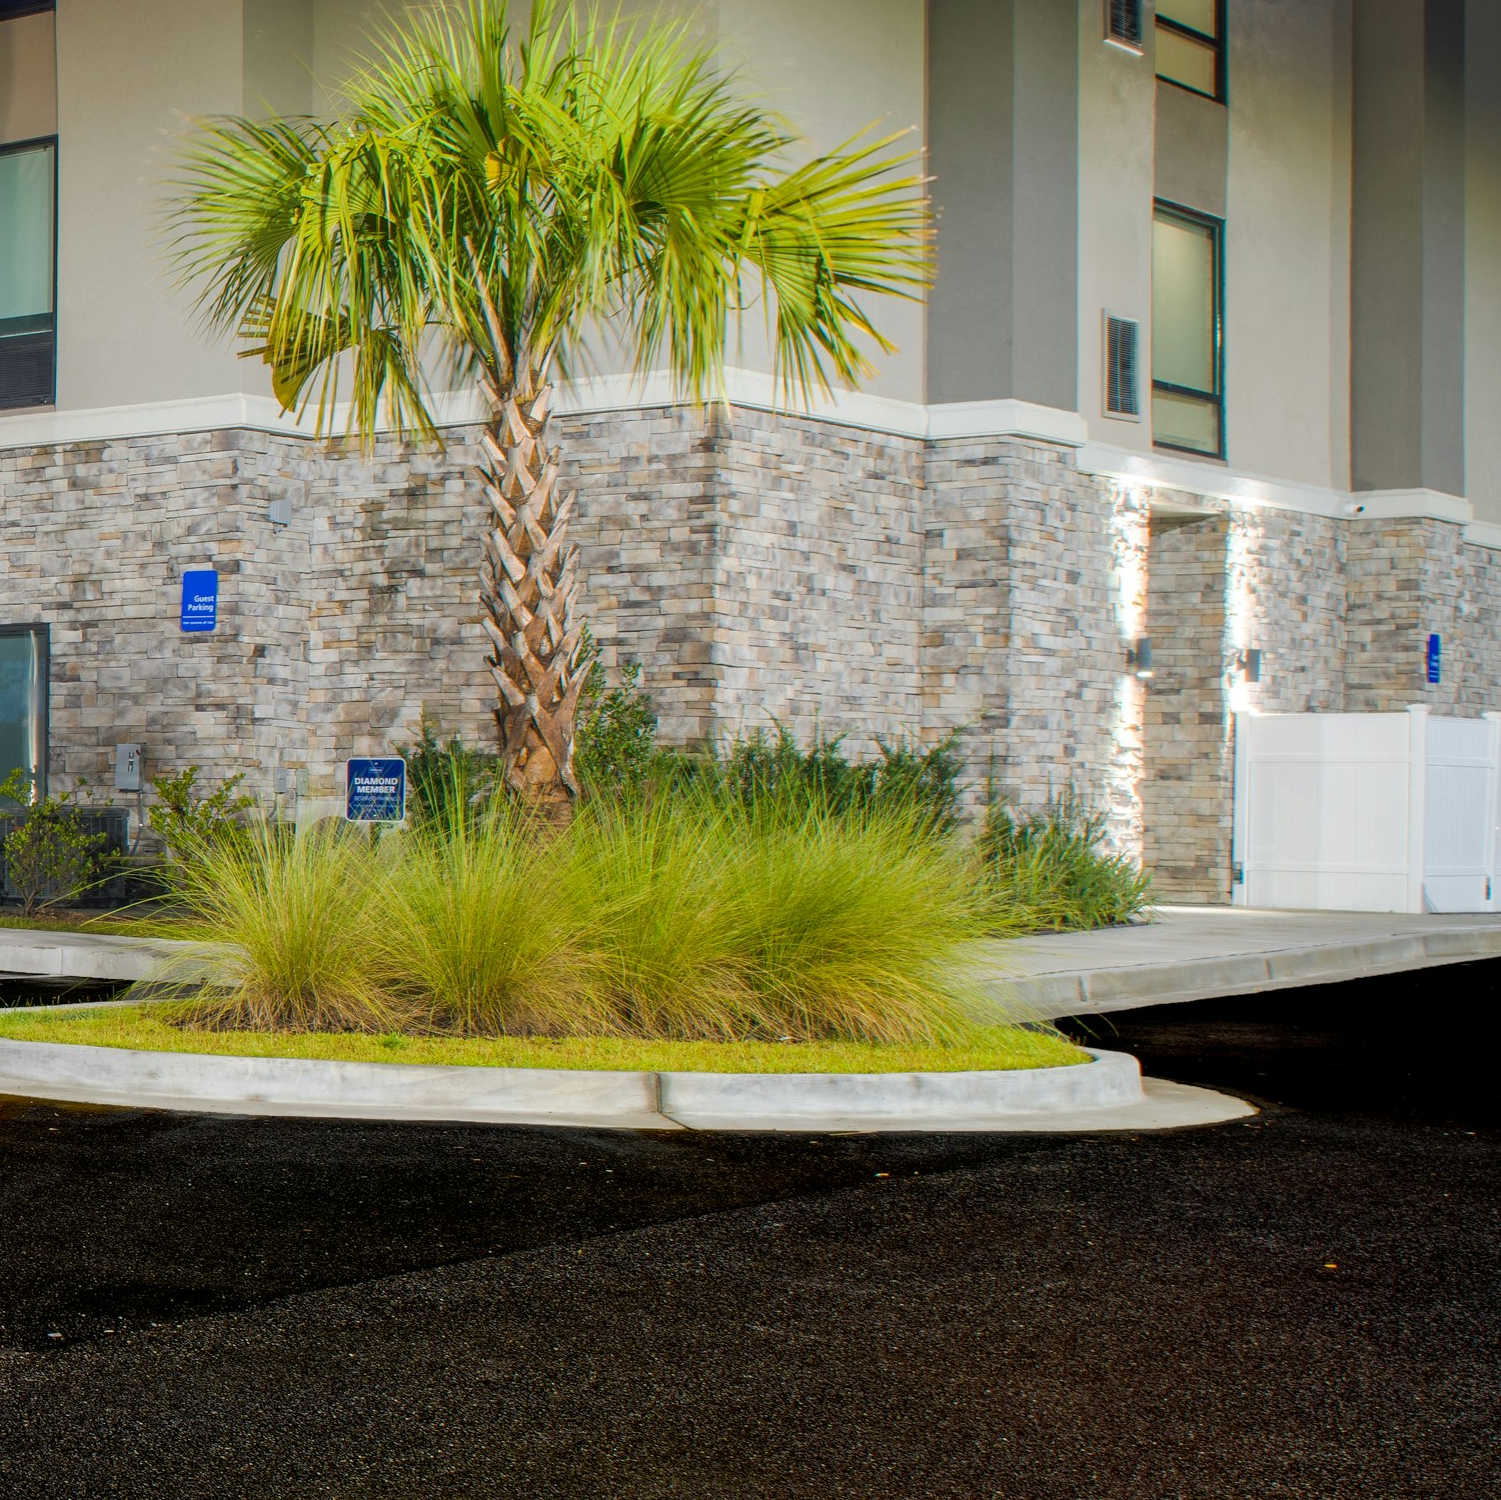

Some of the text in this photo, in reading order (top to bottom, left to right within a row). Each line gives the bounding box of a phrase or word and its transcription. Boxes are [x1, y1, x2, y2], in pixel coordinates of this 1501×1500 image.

[187, 603, 214, 613] Parking
[354, 777, 399, 785] DIAMOND
[356, 785, 396, 793] MEMBER
